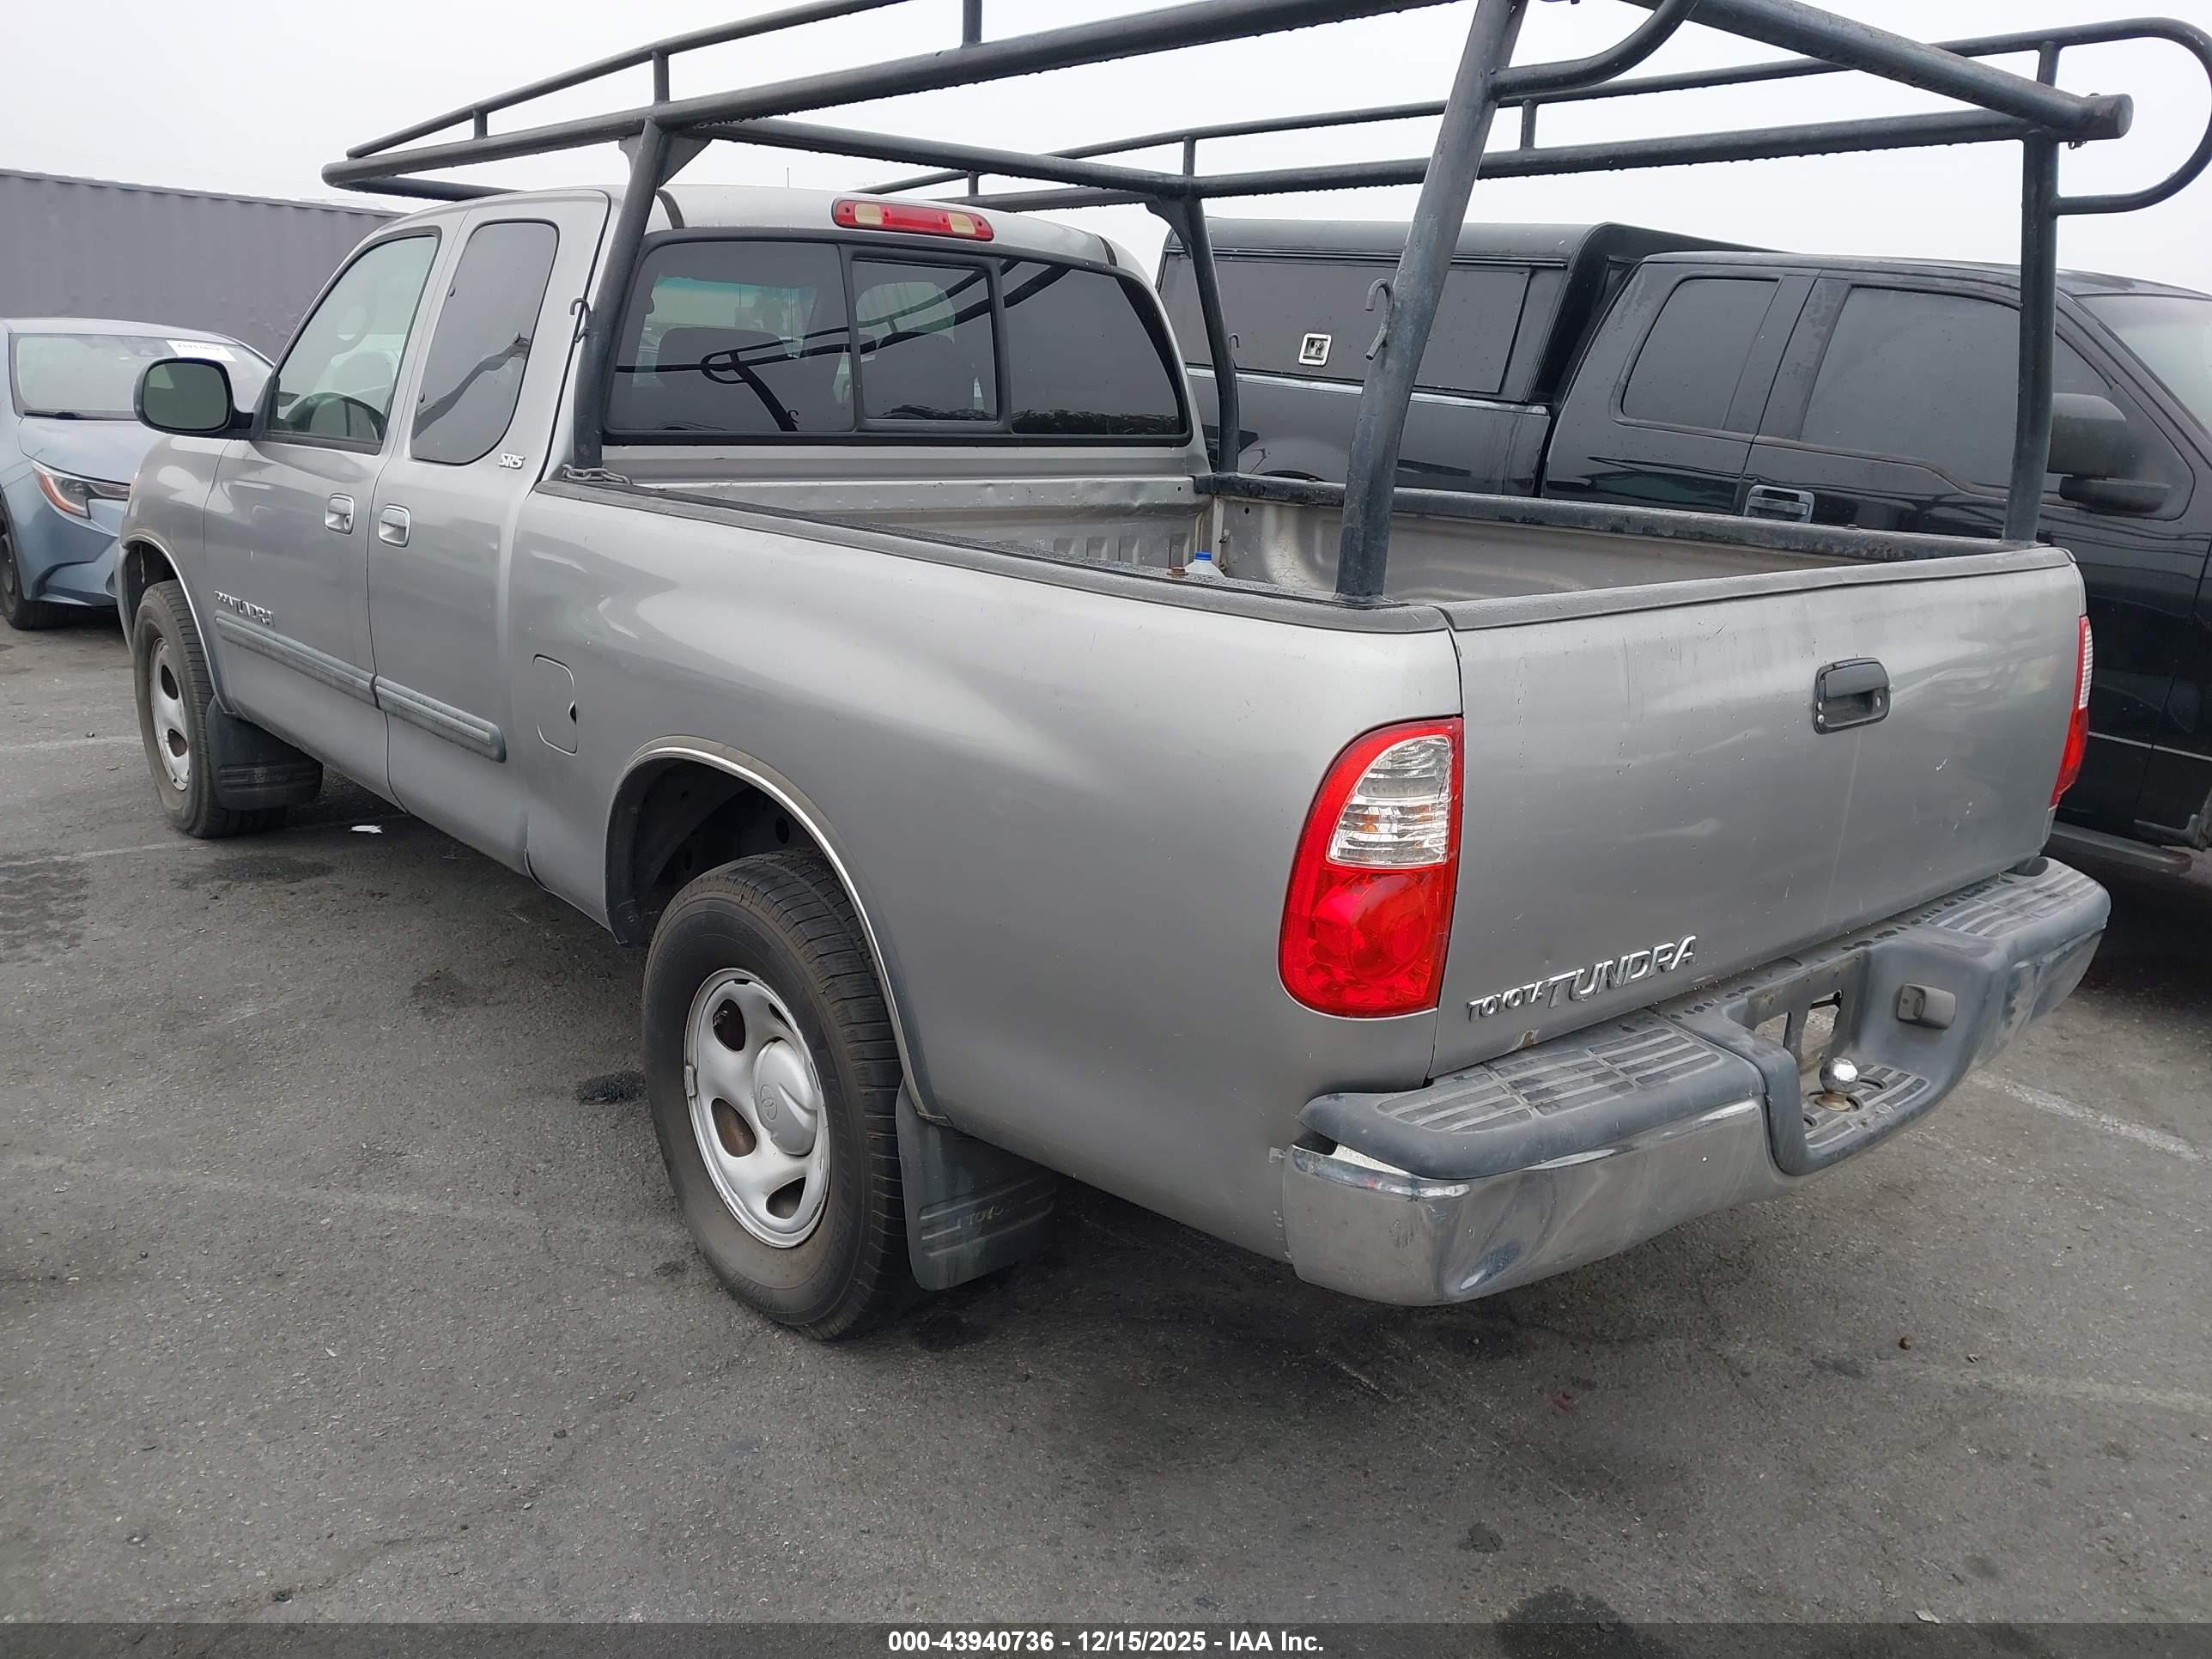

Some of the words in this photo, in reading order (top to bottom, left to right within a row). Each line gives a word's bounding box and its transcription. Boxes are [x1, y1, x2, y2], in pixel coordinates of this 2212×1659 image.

[498, 453, 525, 469] SR5
[1466, 981, 1549, 1022] TOYOTA
[1547, 934, 1698, 1009] TUNDRA
